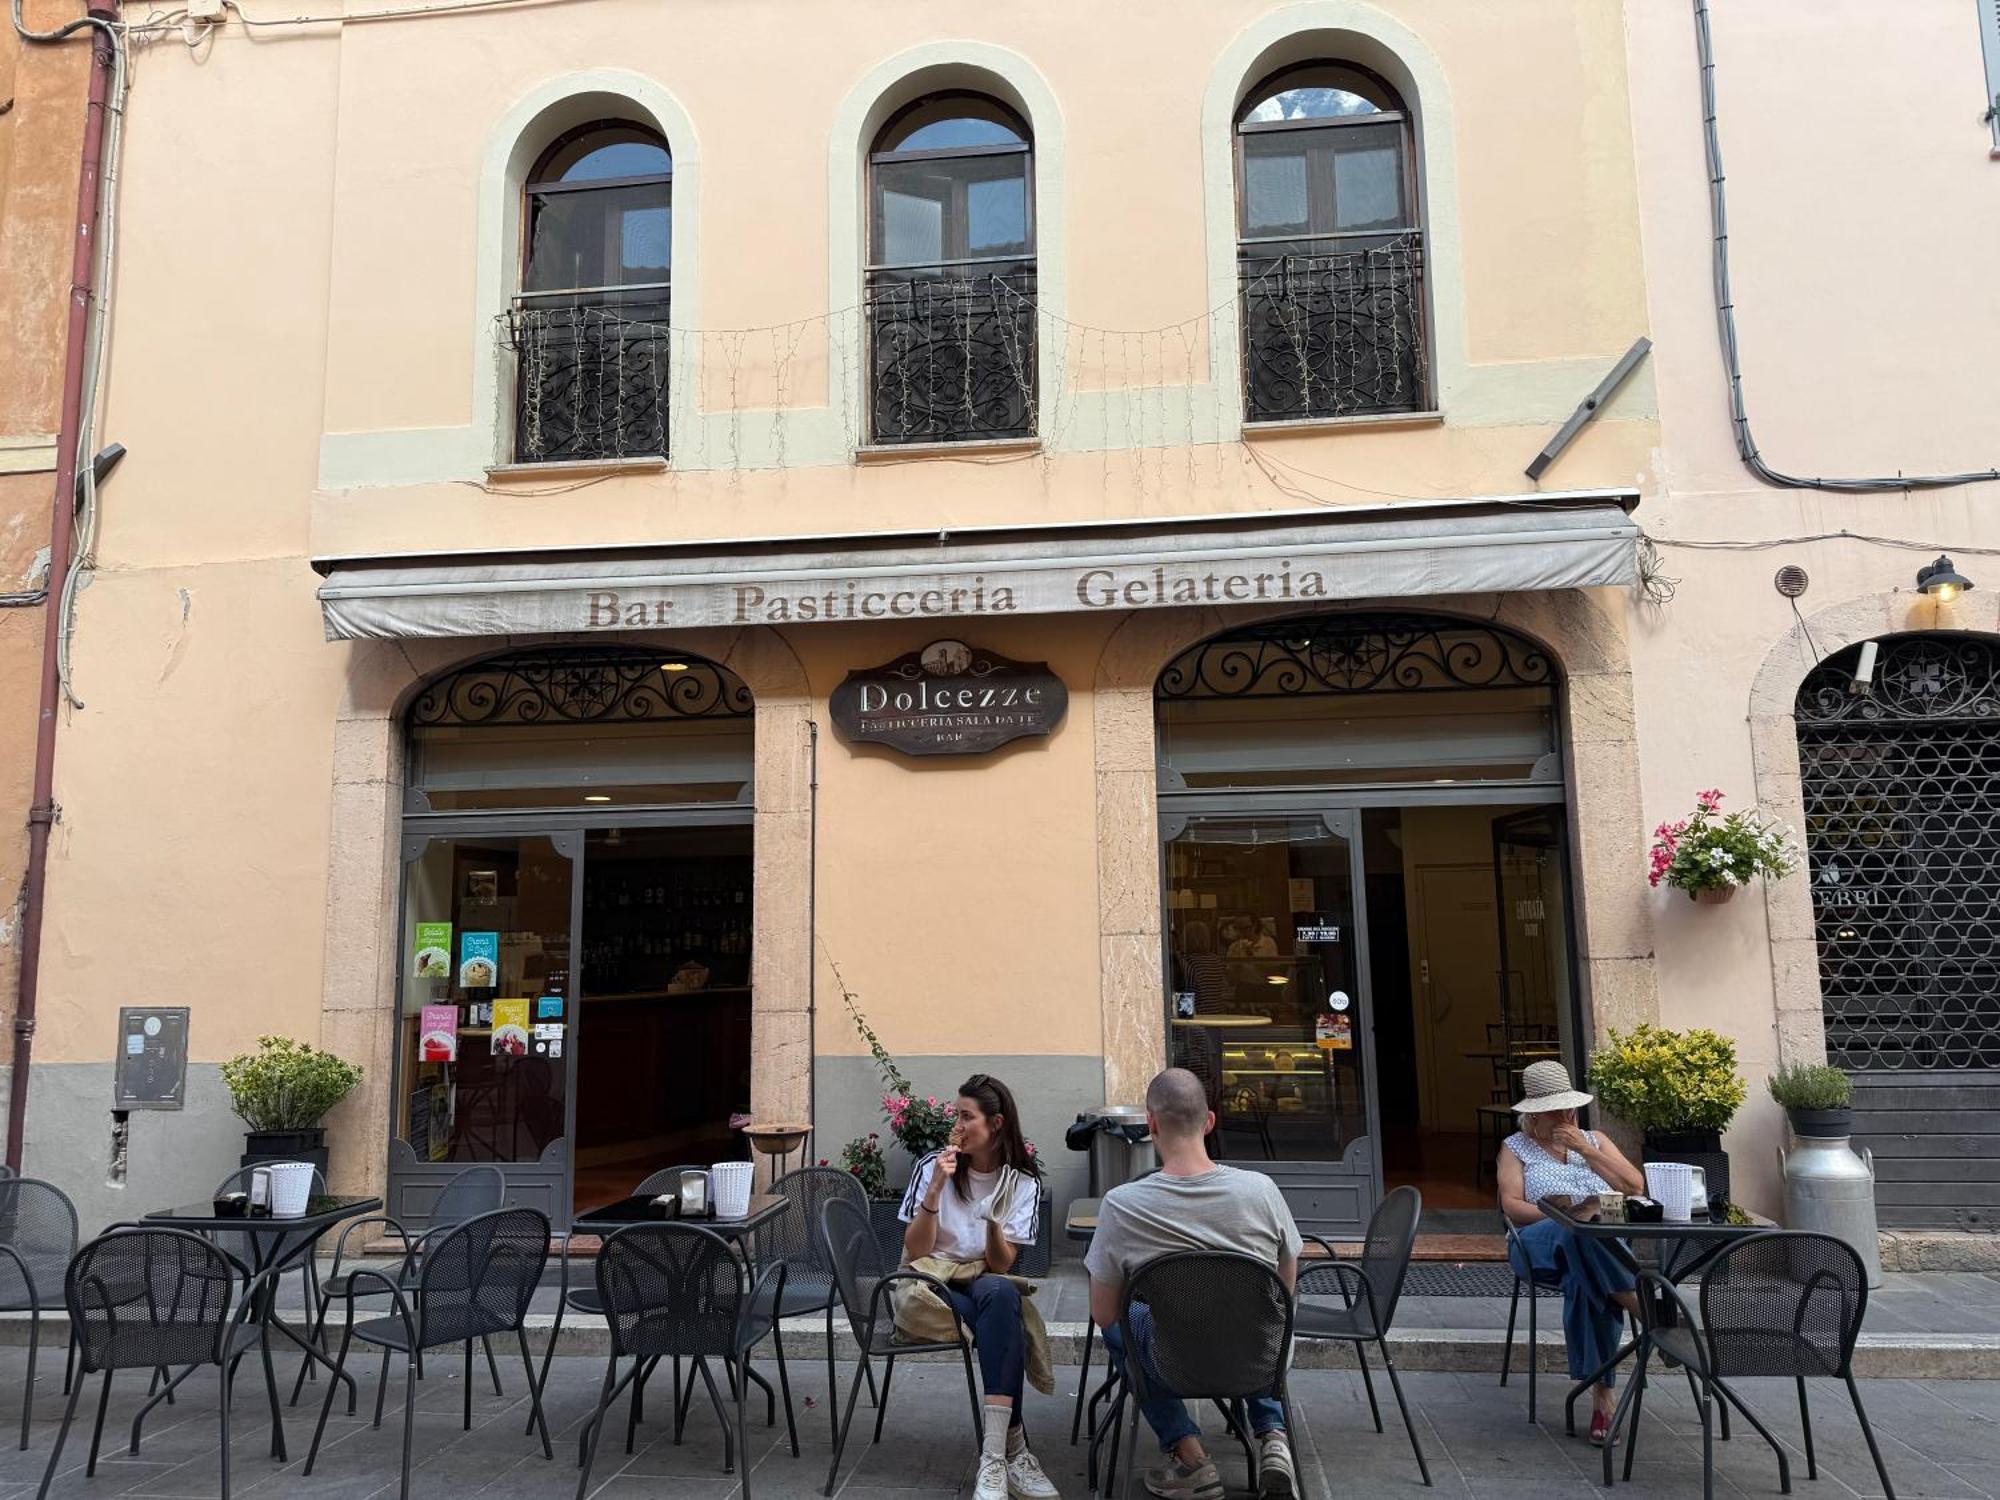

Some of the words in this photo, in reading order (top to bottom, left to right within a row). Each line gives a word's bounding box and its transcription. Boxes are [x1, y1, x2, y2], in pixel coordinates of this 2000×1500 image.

[584, 590, 675, 629] Bar
[731, 575, 1018, 625] Pasticceria
[1076, 560, 1328, 608] Gelateria
[859, 680, 1041, 712] Dolcezze
[956, 715, 991, 727] SALA
